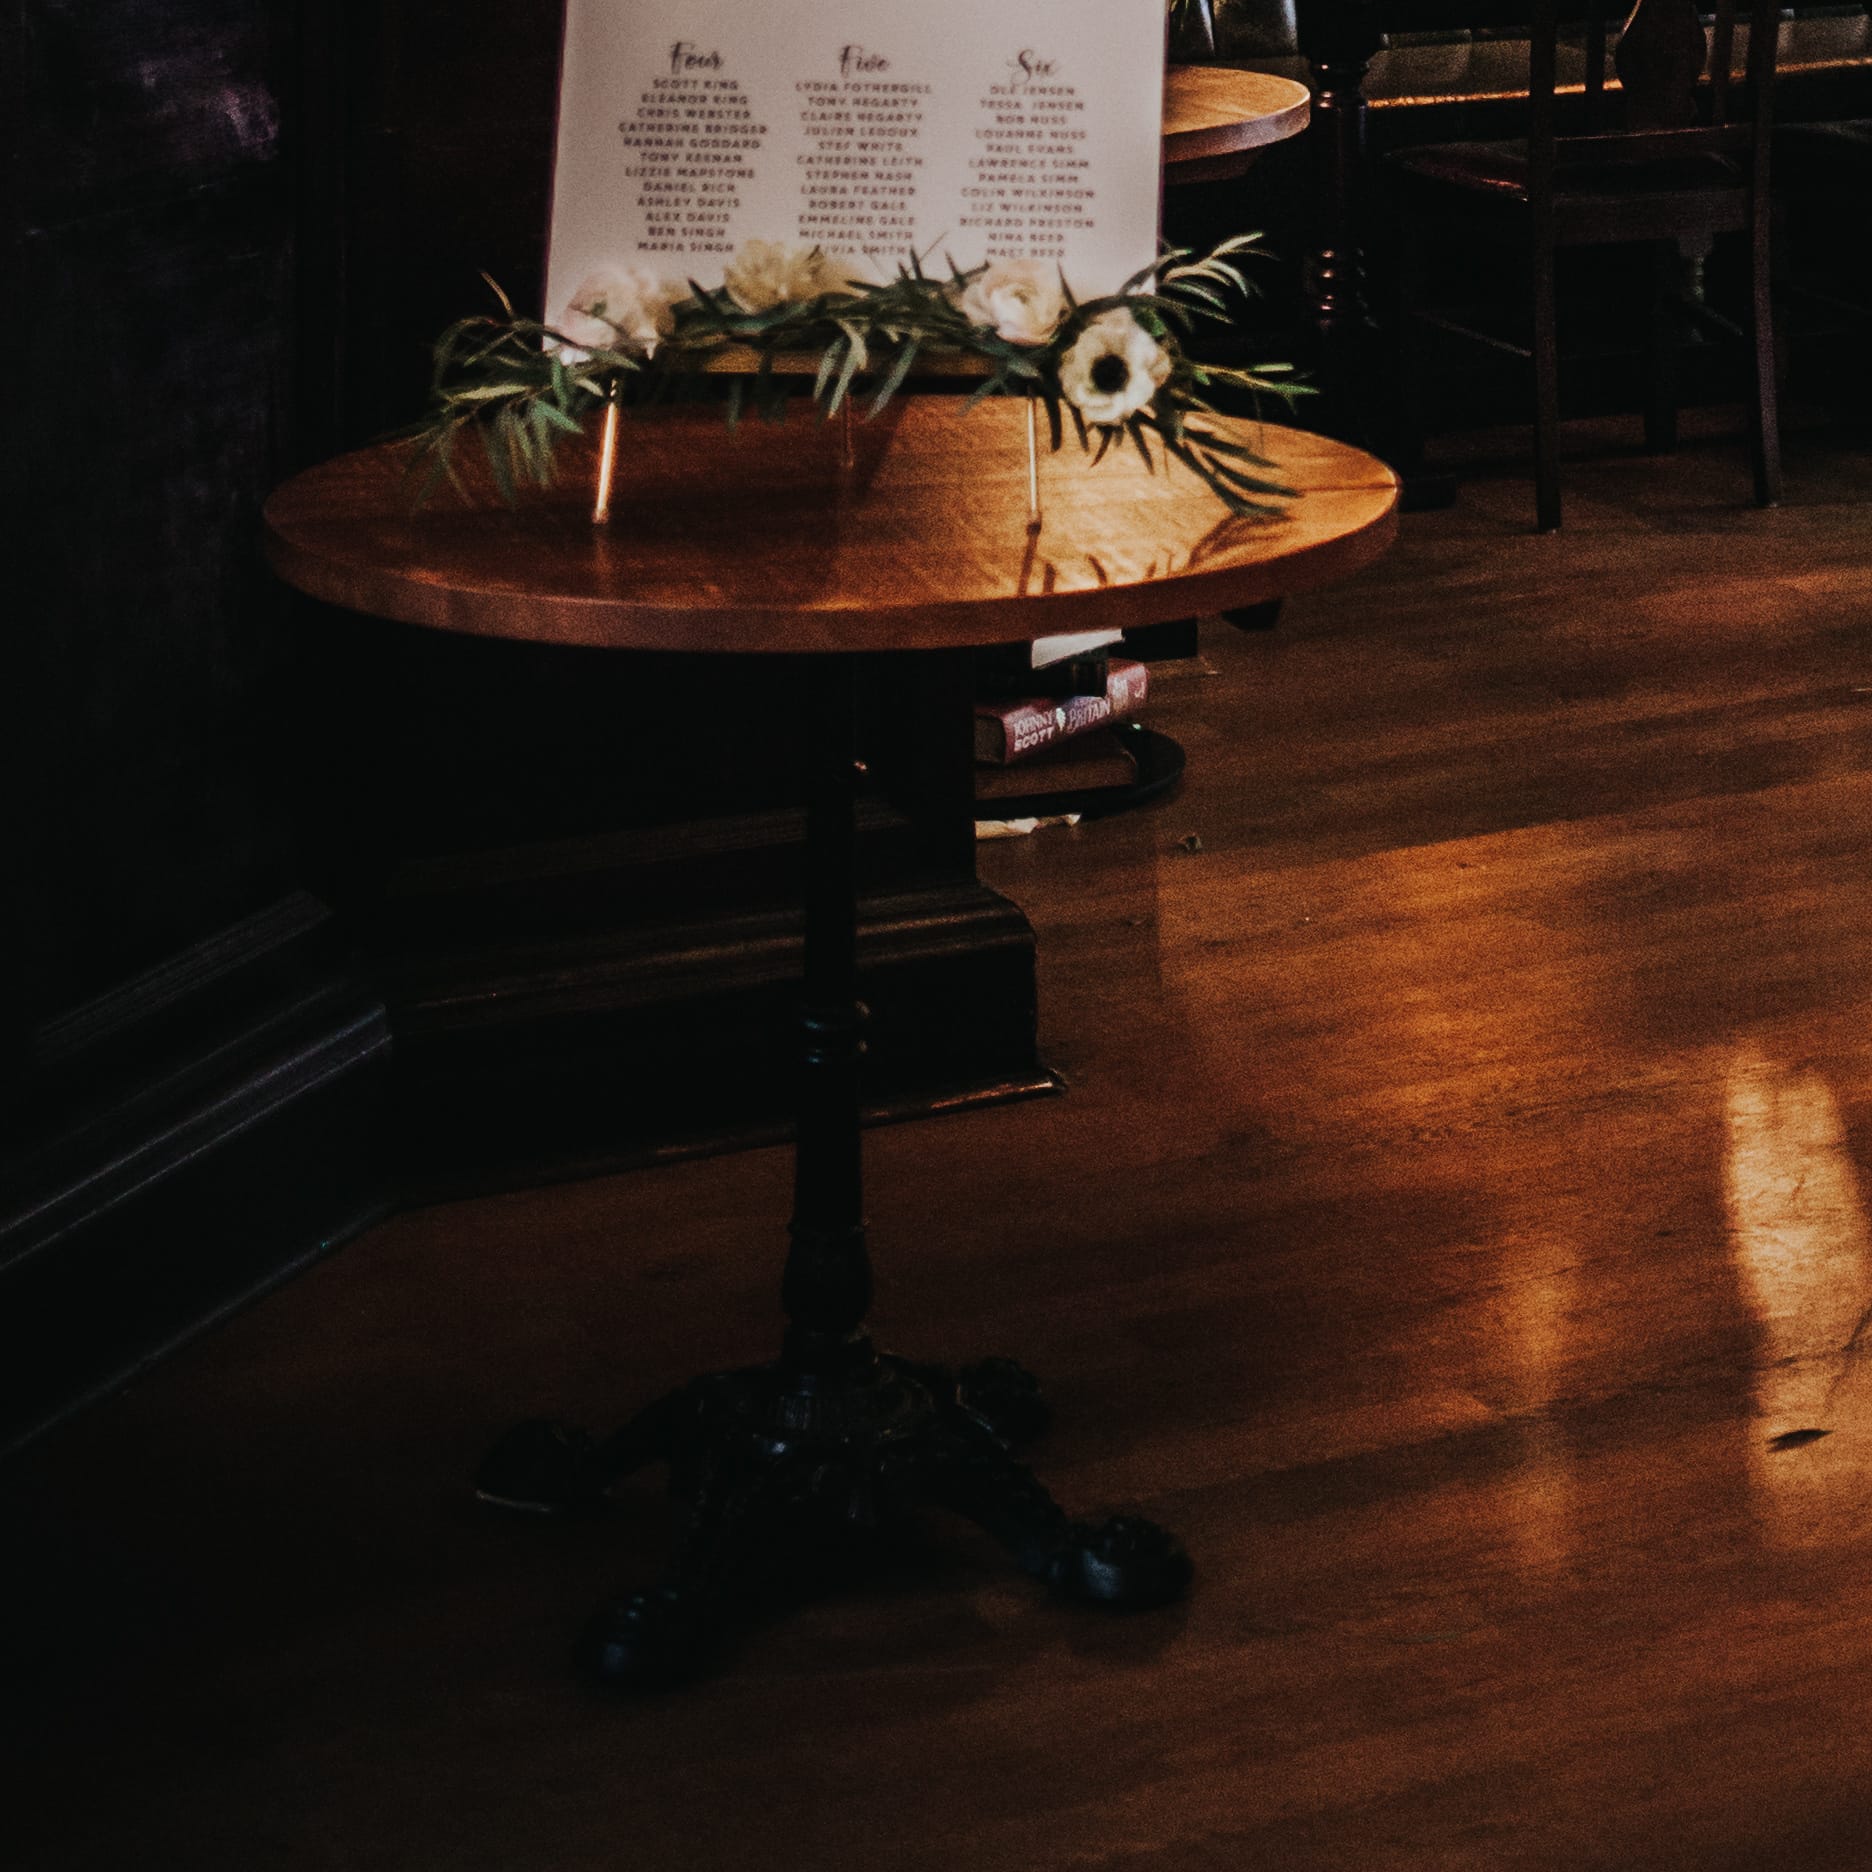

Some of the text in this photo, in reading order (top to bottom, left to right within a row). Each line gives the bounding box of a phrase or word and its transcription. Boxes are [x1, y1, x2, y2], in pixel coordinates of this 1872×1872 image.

[669, 41, 724, 75] Four
[839, 45, 889, 78] Five
[1006, 48, 1057, 85] Six
[1014, 709, 1055, 739] JOHNNY
[1014, 726, 1055, 753] SCOTT
